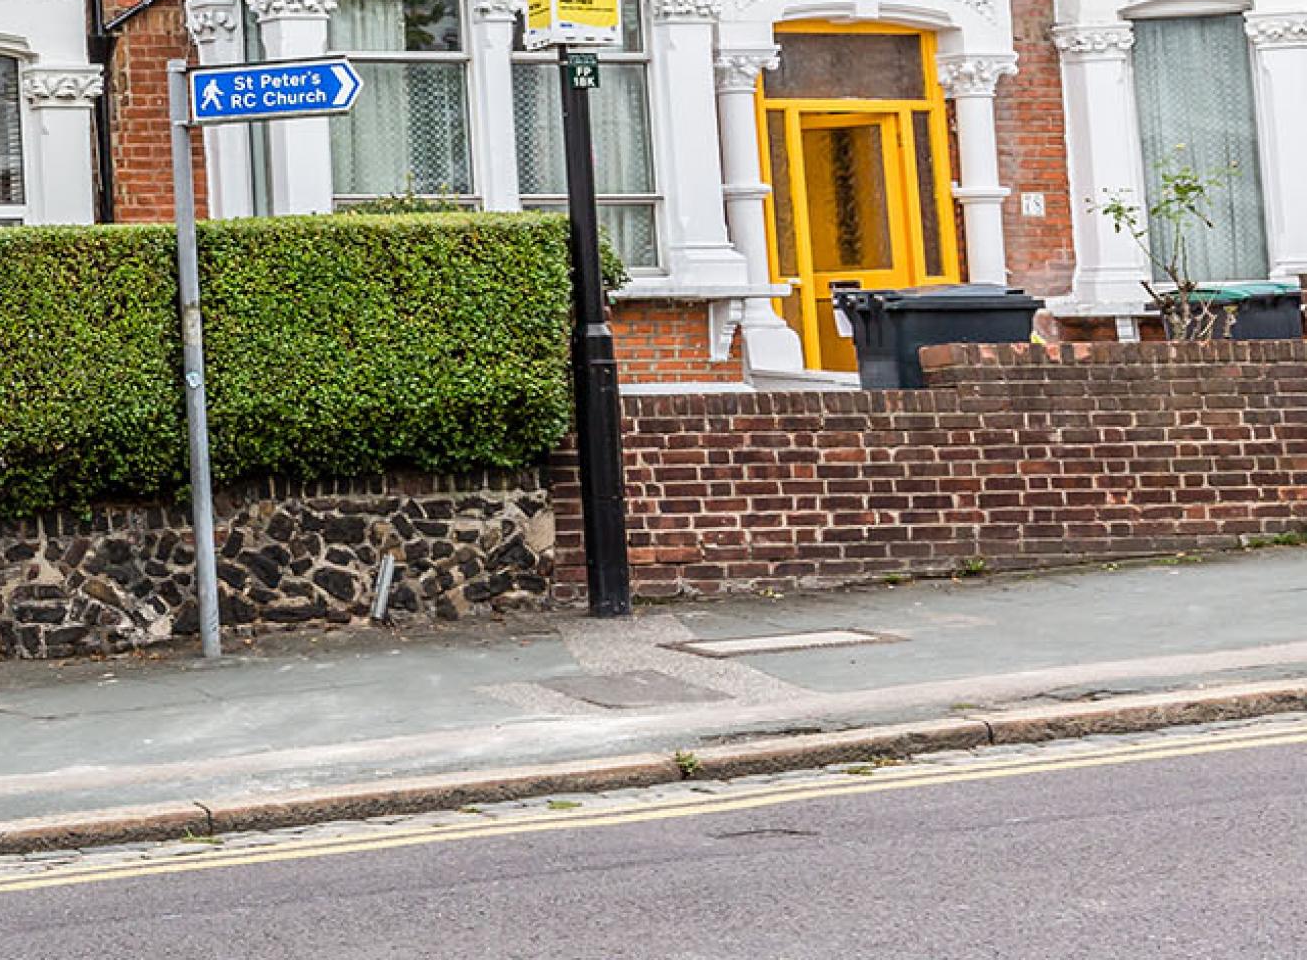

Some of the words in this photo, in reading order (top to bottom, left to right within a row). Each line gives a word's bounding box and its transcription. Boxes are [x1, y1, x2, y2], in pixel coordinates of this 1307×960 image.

[233, 75, 254, 91] St
[260, 71, 321, 89] Peter's
[230, 93, 257, 109] RC
[262, 90, 327, 106] Church
